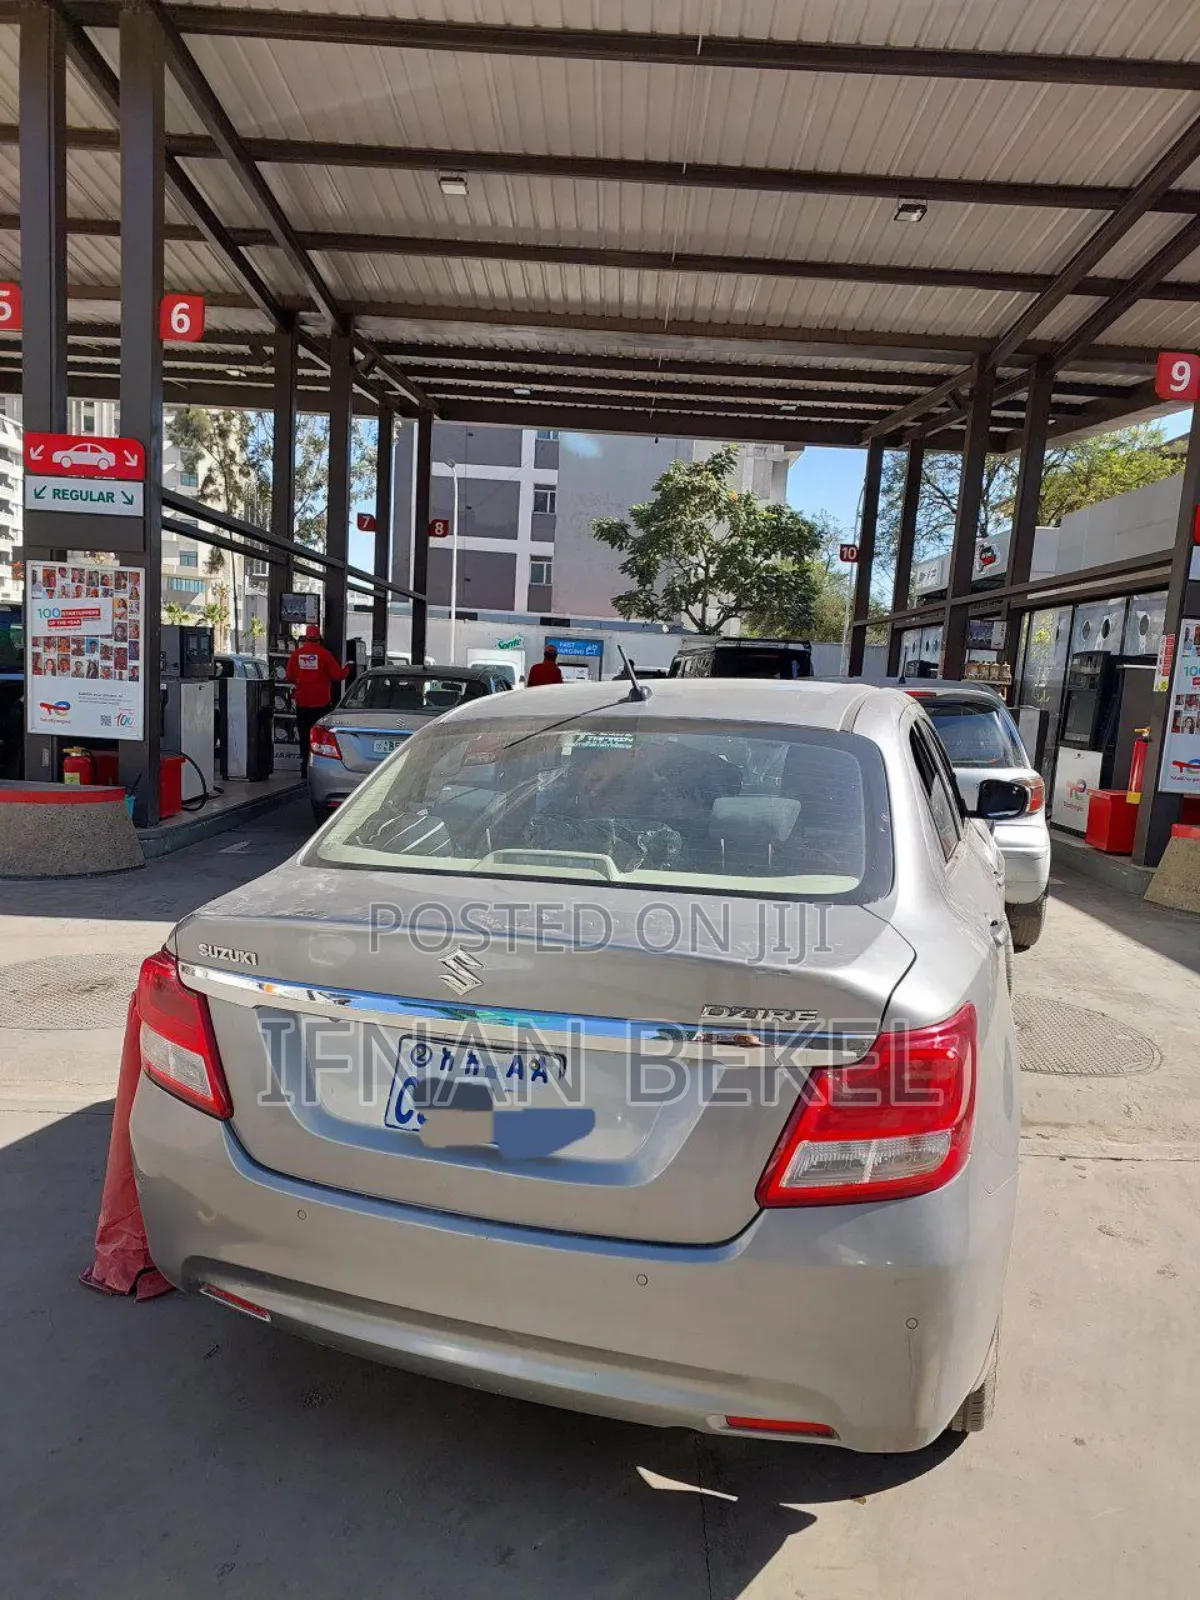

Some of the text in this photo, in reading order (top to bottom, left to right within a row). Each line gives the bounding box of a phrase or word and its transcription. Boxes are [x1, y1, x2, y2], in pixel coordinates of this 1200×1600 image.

[170, 302, 191, 334] 6
[1170, 360, 1191, 392] 9
[52, 488, 115, 503] REGULAR
[361, 515, 371, 528] 7
[434, 521, 444, 535] 8
[842, 547, 857, 560] 10
[37, 607, 60, 618] 100
[559, 641, 576, 649] FAST
[198, 942, 259, 967] SUZUKI
[700, 1003, 820, 1025] DZIRE
